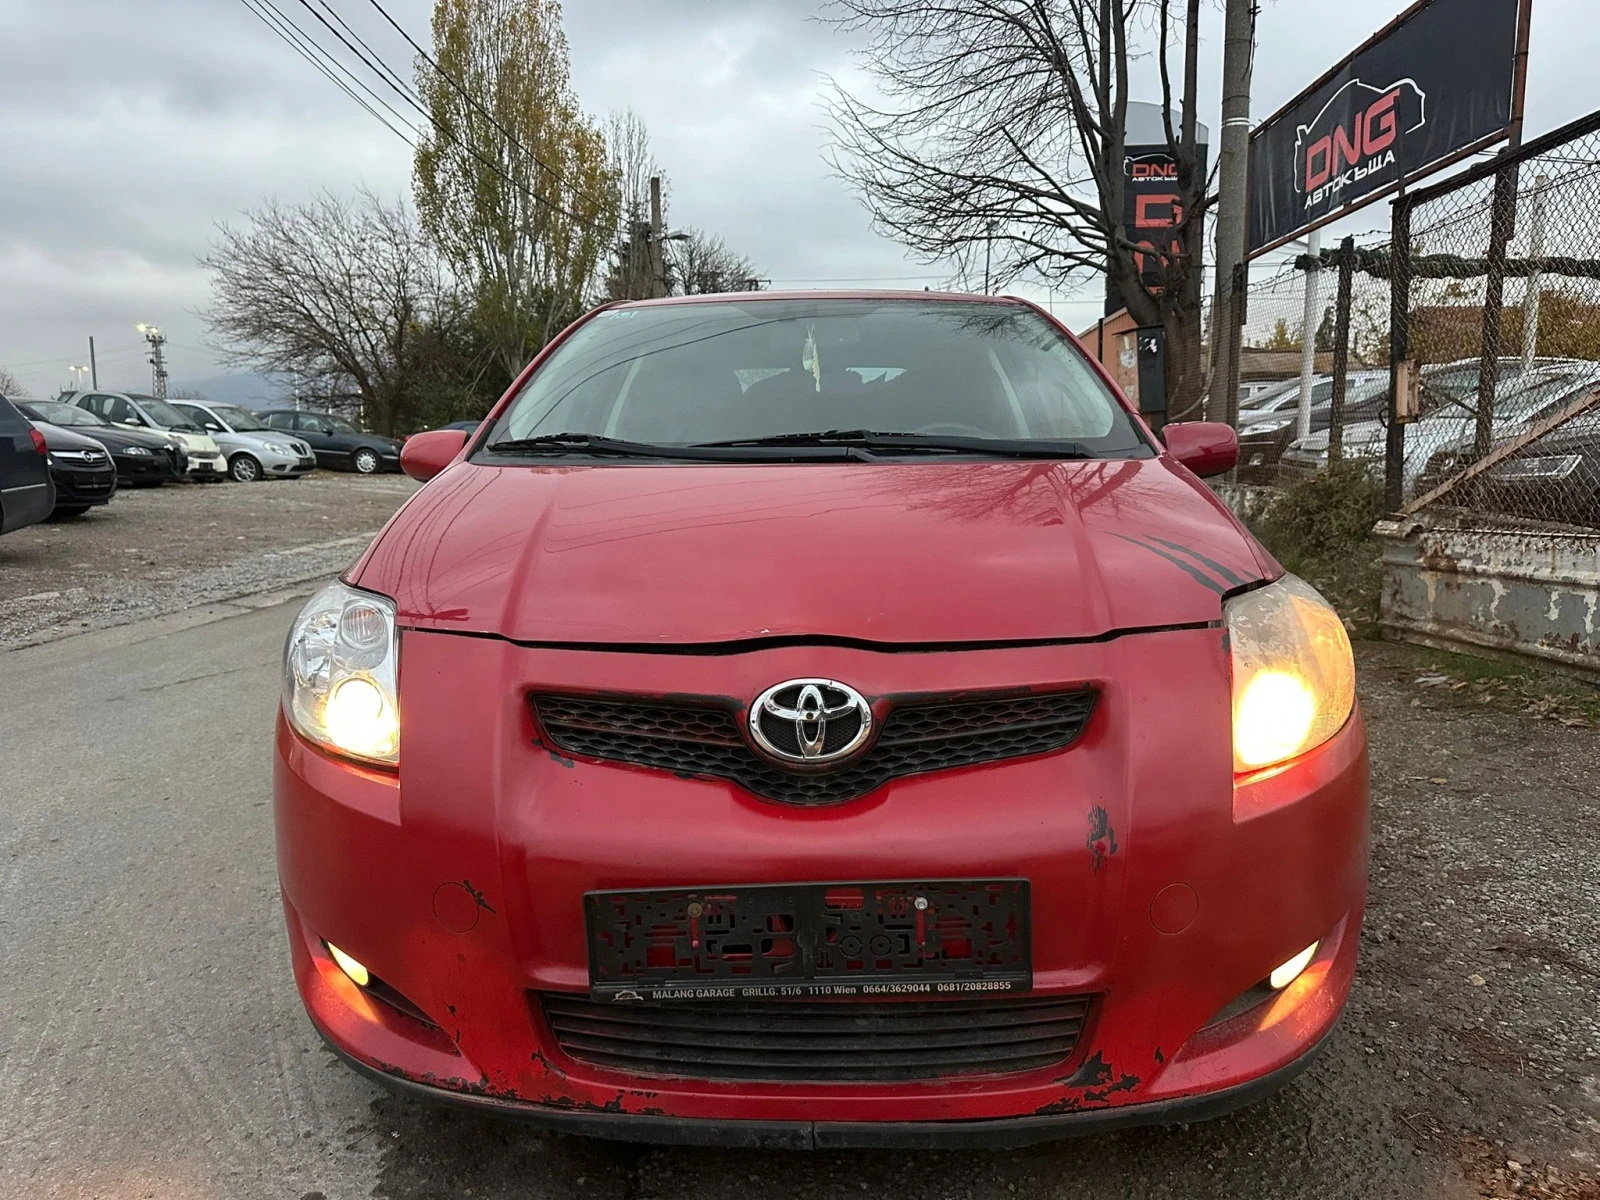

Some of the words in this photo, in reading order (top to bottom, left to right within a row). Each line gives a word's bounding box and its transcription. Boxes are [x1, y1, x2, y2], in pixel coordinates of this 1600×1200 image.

[1305, 87, 1401, 193] DNG
[652, 989, 694, 999] MALANG
[696, 988, 735, 998] GARAGE
[742, 987, 779, 997] GRILLG.
[781, 986, 802, 996] 51/6
[808, 985, 831, 995] 1110
[833, 985, 857, 995] Wien
[862, 984, 930, 994] 0664/3629044
[937, 981, 1011, 993] 0681/20828855
